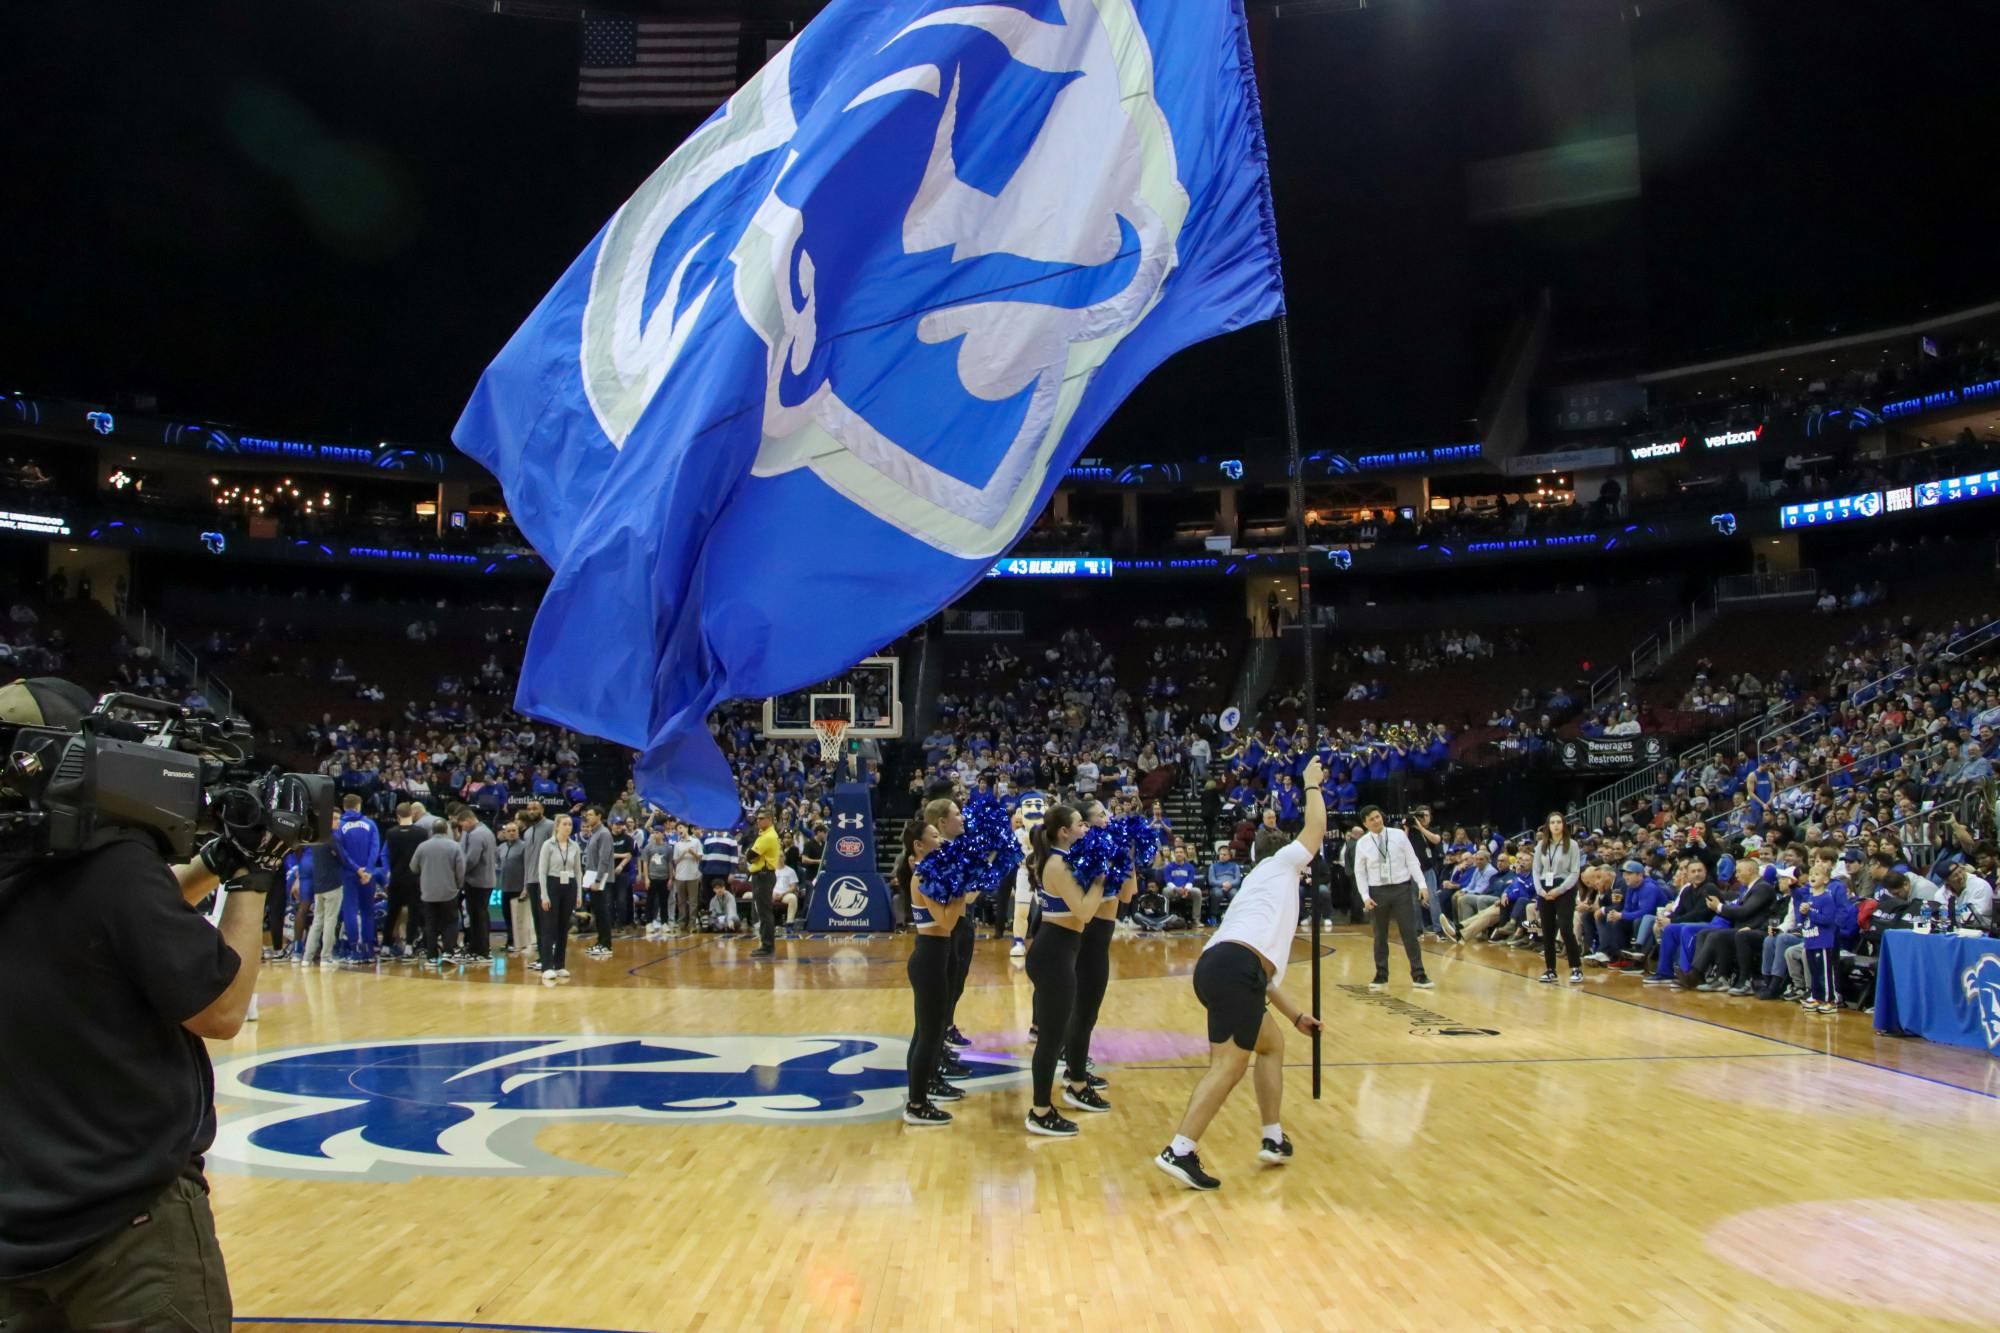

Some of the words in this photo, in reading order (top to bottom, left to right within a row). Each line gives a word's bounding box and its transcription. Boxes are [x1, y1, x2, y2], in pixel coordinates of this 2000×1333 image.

[1704, 430, 1757, 448] verizon
[1631, 442, 1681, 459] verizon
[1008, 560, 1028, 575] 43
[1029, 560, 1077, 574] BLUEJAYS
[1588, 742, 1633, 751] Beverages
[1588, 754, 1634, 764] Restrooms
[163, 769, 195, 779] Panasonic
[277, 817, 296, 828] Canon
